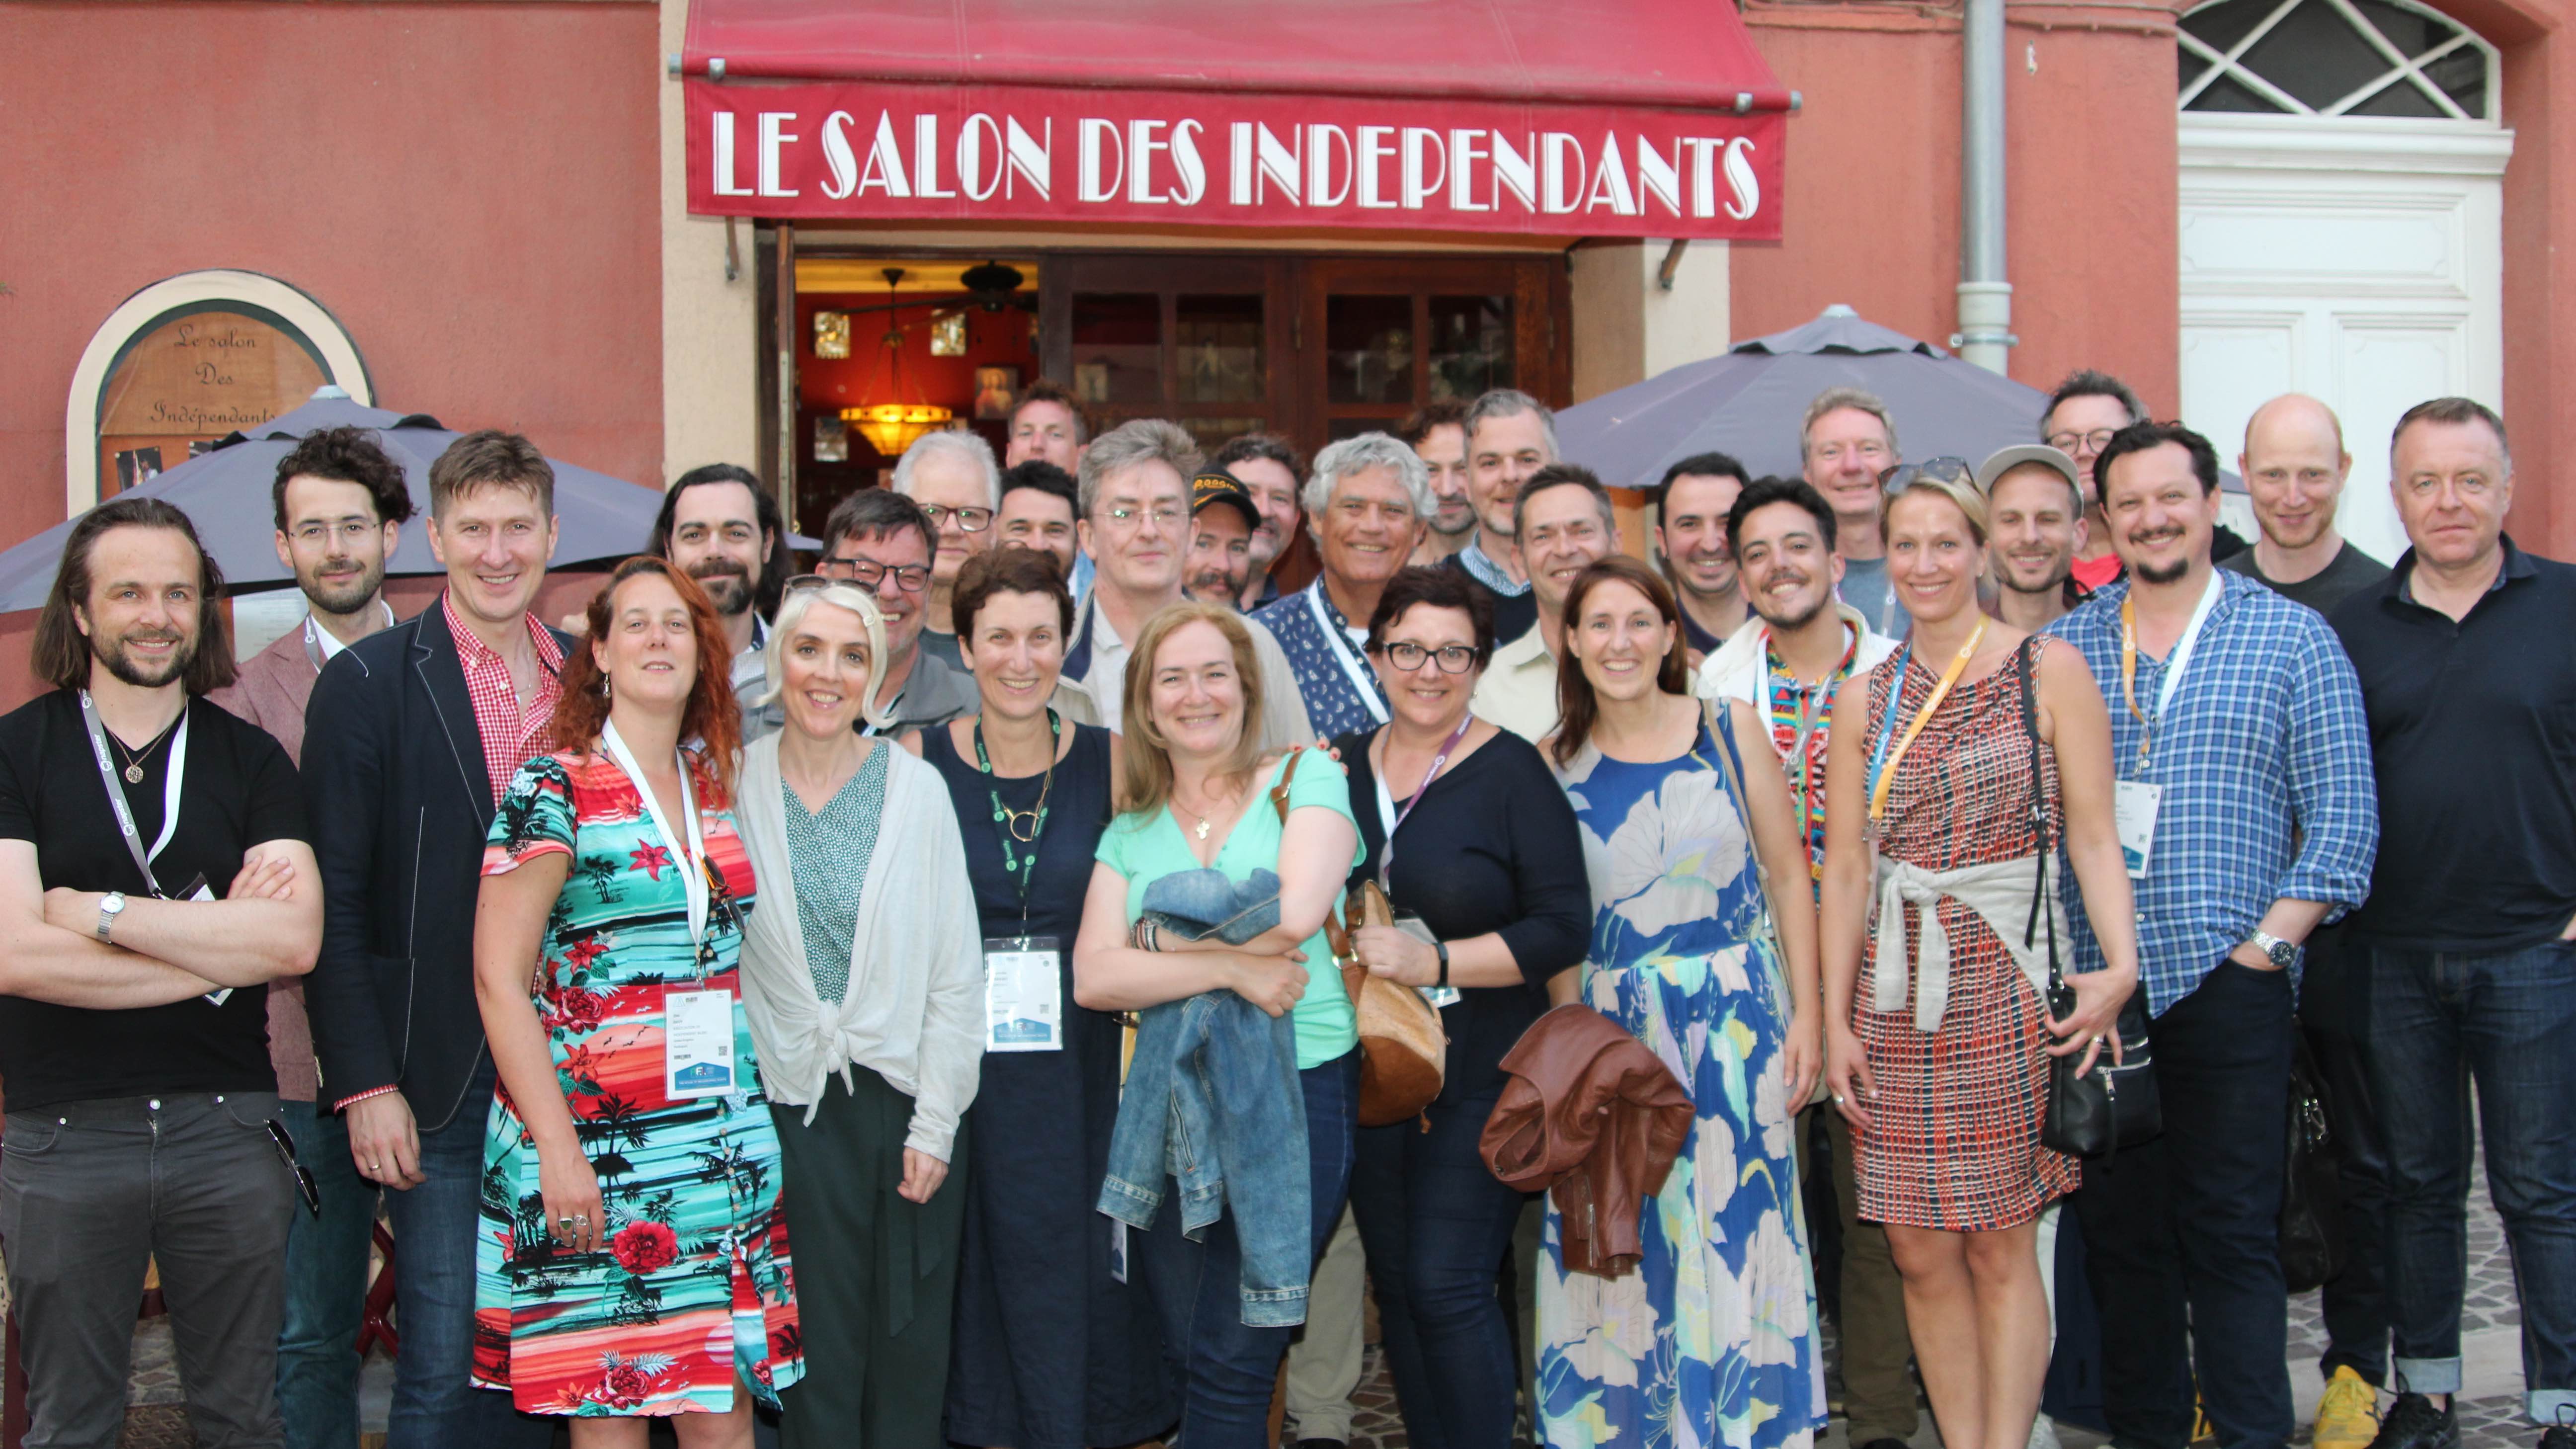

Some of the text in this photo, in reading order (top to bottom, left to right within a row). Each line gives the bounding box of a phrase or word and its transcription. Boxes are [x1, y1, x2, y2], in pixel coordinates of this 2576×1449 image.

[713, 109, 1760, 220] LE SALON DES INDEPENDANTS
[174, 324, 255, 348] Le salon
[195, 362, 234, 385] Des
[94, 734, 107, 760] napster
[115, 798, 129, 824] napster
